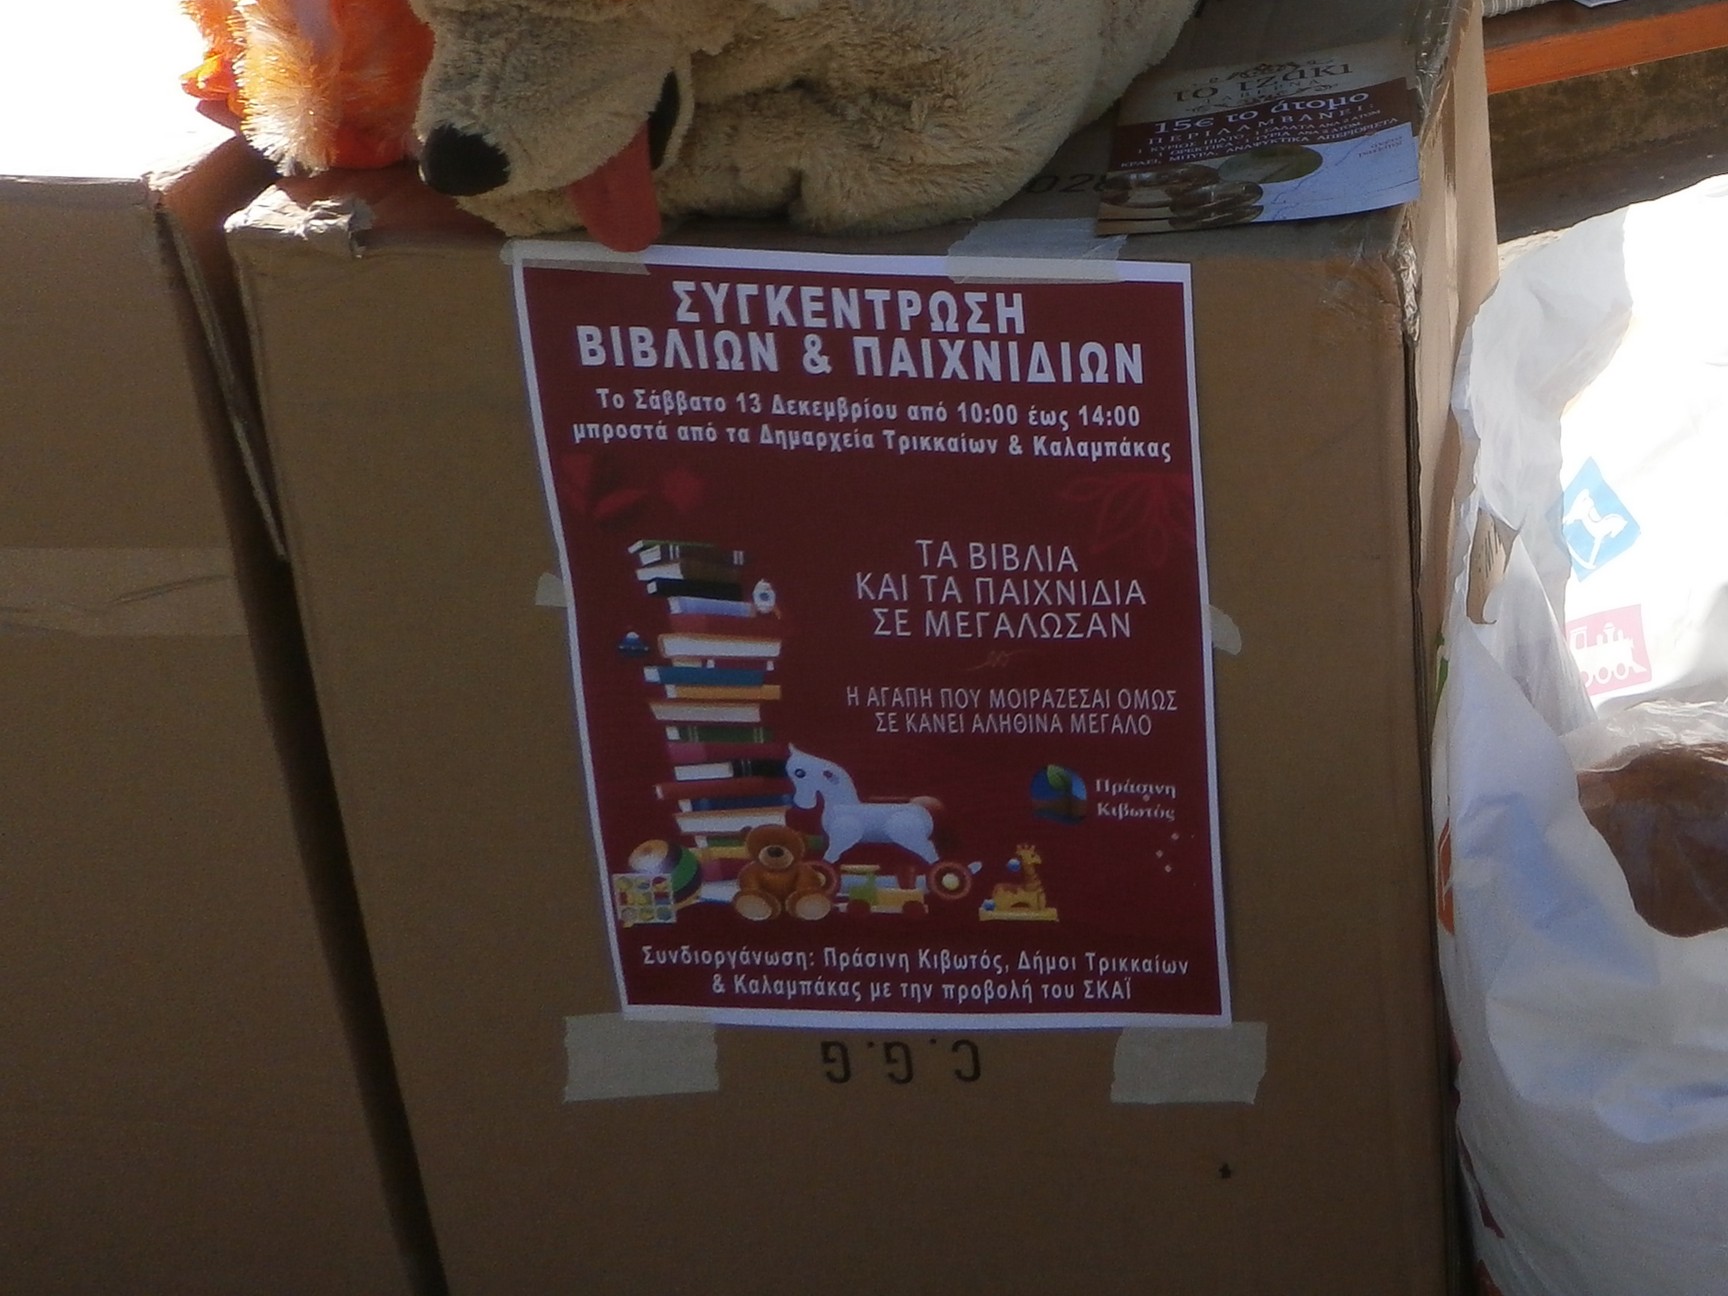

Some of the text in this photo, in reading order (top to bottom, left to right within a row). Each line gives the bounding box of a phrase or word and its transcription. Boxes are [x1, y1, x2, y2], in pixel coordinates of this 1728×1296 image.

[1270, 92, 1369, 114] άτομο
[671, 280, 1026, 334] ΣΥΓΚΕΝΤΡΩΣΗ
[576, 324, 1144, 385] ΒΙΒΛΙΩΝ & ΠΑΙΧΝΙΔΙΩΝ
[596, 388, 1140, 431] Το Σάββατο 13 Δεκεμβρίου από 10:00 έως 14:00
[573, 421, 1172, 463] μπροστά από τα Δημαρχεία Τρικκαίων & Καλαμπάκας
[915, 539, 1079, 572] ΤΑ ΒΙΒΛΙΑ
[855, 571, 1147, 606] ΚΑΙ ΤΑ ΠΑΙΧΝΙΔΙΑ
[872, 607, 1131, 639] ΣΕ ΜΕΓΑΛΩΣΑΝ
[846, 685, 1178, 711] Η ΑΓΑΠΗ ΠΟΥ ΜΟΙΡΑΖΕΣΑΙ ΟΜΩΣ
[875, 712, 1152, 736] ΣΕ ΚΑΝΕΙ ΑΛΗΘΙΝΑ ΜΕΓΑΛΟ
[1095, 778, 1177, 800] Πράσινη
[642, 945, 1188, 976] Συνδιοργάνωση: Πράσινη Κιβωτός, Δήμοι Τρικκαίων
[712, 974, 1132, 1004] & Καλαμπάκας με την προβολή του ΣΚΑΪ
